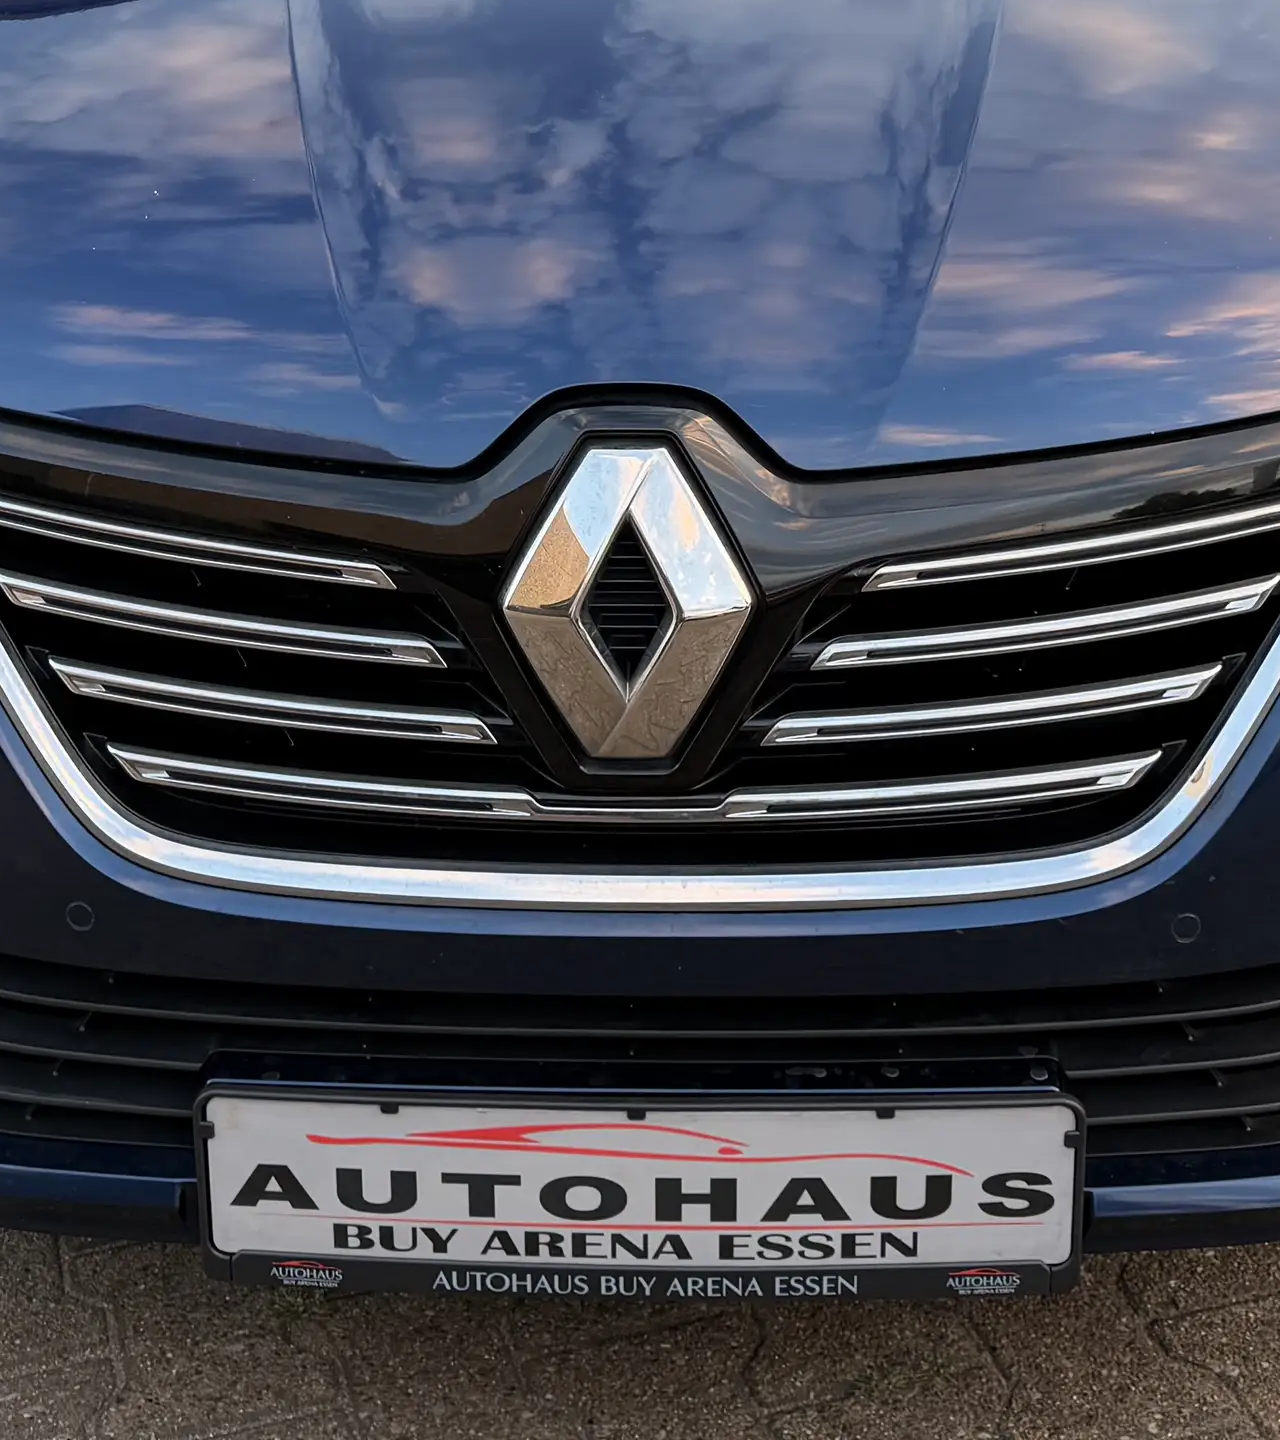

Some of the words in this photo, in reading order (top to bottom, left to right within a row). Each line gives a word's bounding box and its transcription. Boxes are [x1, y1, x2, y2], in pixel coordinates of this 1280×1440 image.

[230, 1163, 1055, 1222] AUTOHAUS
[333, 1223, 459, 1253] BUY
[480, 1229, 693, 1260] ARENA
[719, 1232, 919, 1260] ESSEN
[270, 1267, 343, 1280] AUTOHAUS
[432, 1270, 590, 1295] AUTOHAUS
[600, 1275, 657, 1296] BUY
[667, 1276, 763, 1298] ARENA
[774, 1275, 859, 1296] ESSEN
[946, 1275, 1020, 1288] AUTOHAUS
